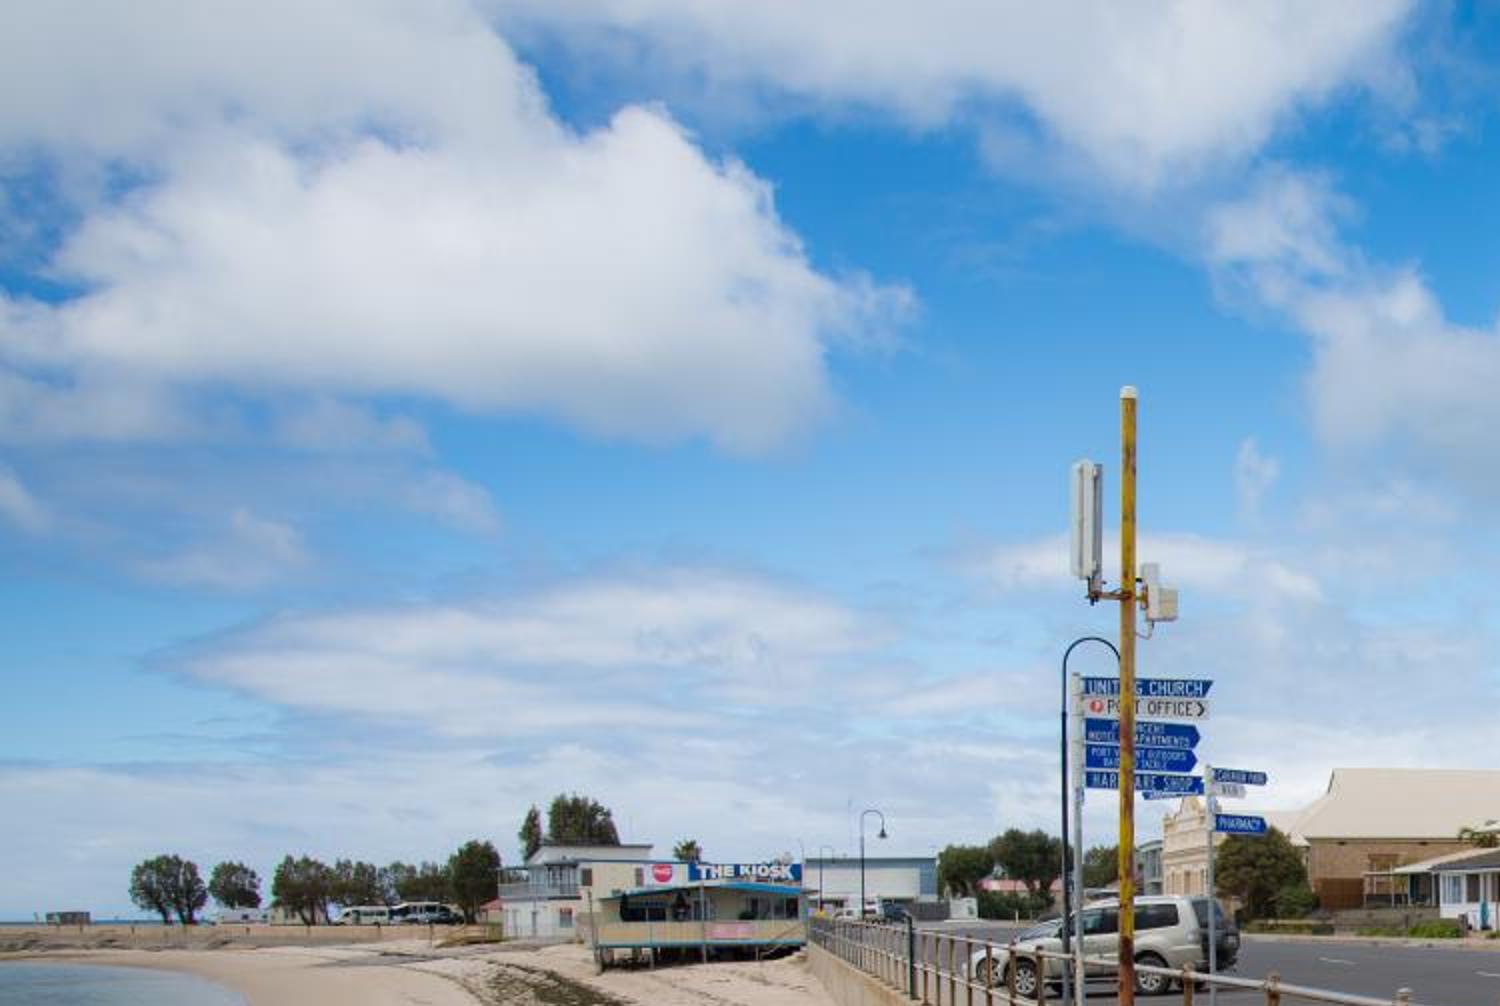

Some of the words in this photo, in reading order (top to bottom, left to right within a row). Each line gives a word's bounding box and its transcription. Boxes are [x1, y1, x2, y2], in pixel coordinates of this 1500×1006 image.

[1087, 679, 1143, 695] UNITG
[1150, 681, 1203, 697] CHURCH
[1107, 699, 1140, 715] PT
[1147, 700, 1193, 716] OFFICE
[1092, 773, 1156, 790] HARARE
[1217, 816, 1261, 830] PHARMACY
[697, 865, 735, 879] THE
[739, 864, 794, 880] KIOSK
